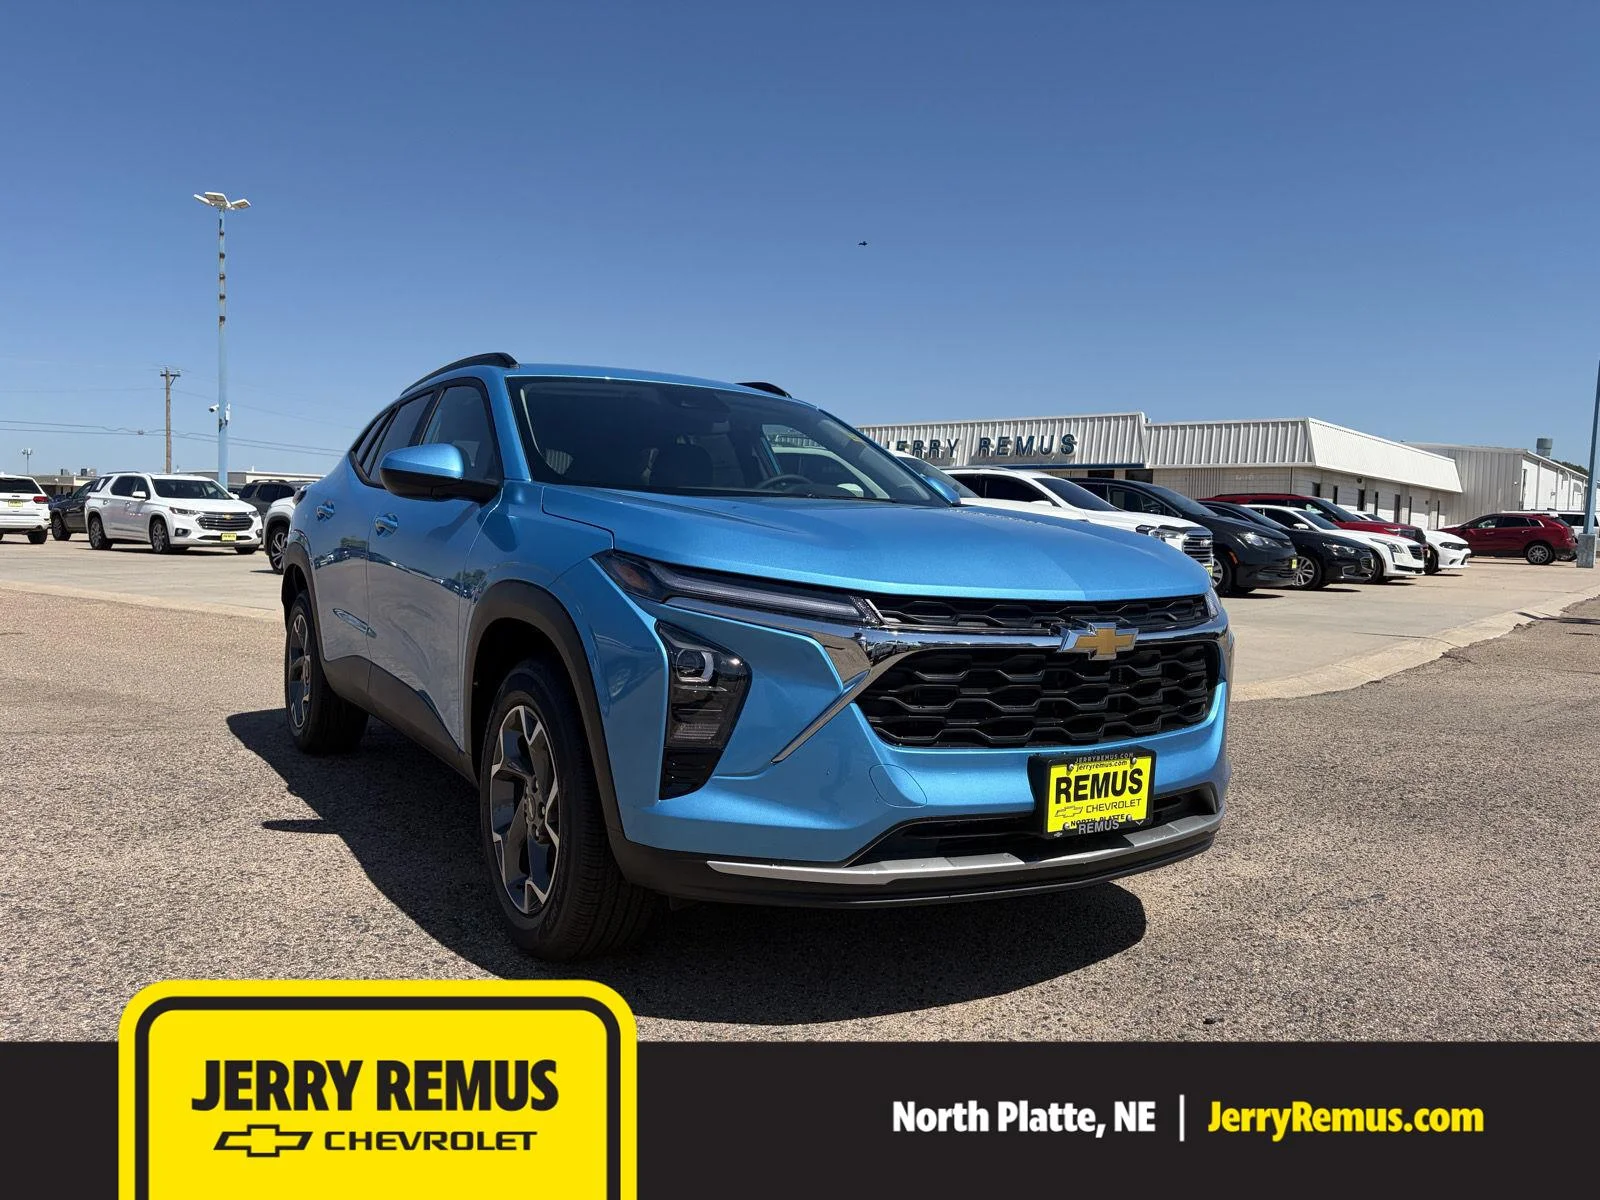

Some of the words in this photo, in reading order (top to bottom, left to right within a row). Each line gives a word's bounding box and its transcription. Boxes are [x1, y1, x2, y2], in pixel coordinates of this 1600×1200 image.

[978, 433, 1076, 457] REMUS
[1075, 753, 1134, 764] JERRYREMUS.COM
[1076, 760, 1128, 772] jerryremus.com
[1055, 768, 1144, 804] REMUS
[1086, 798, 1142, 814] CHEVROLET
[1078, 819, 1120, 835] REMUS
